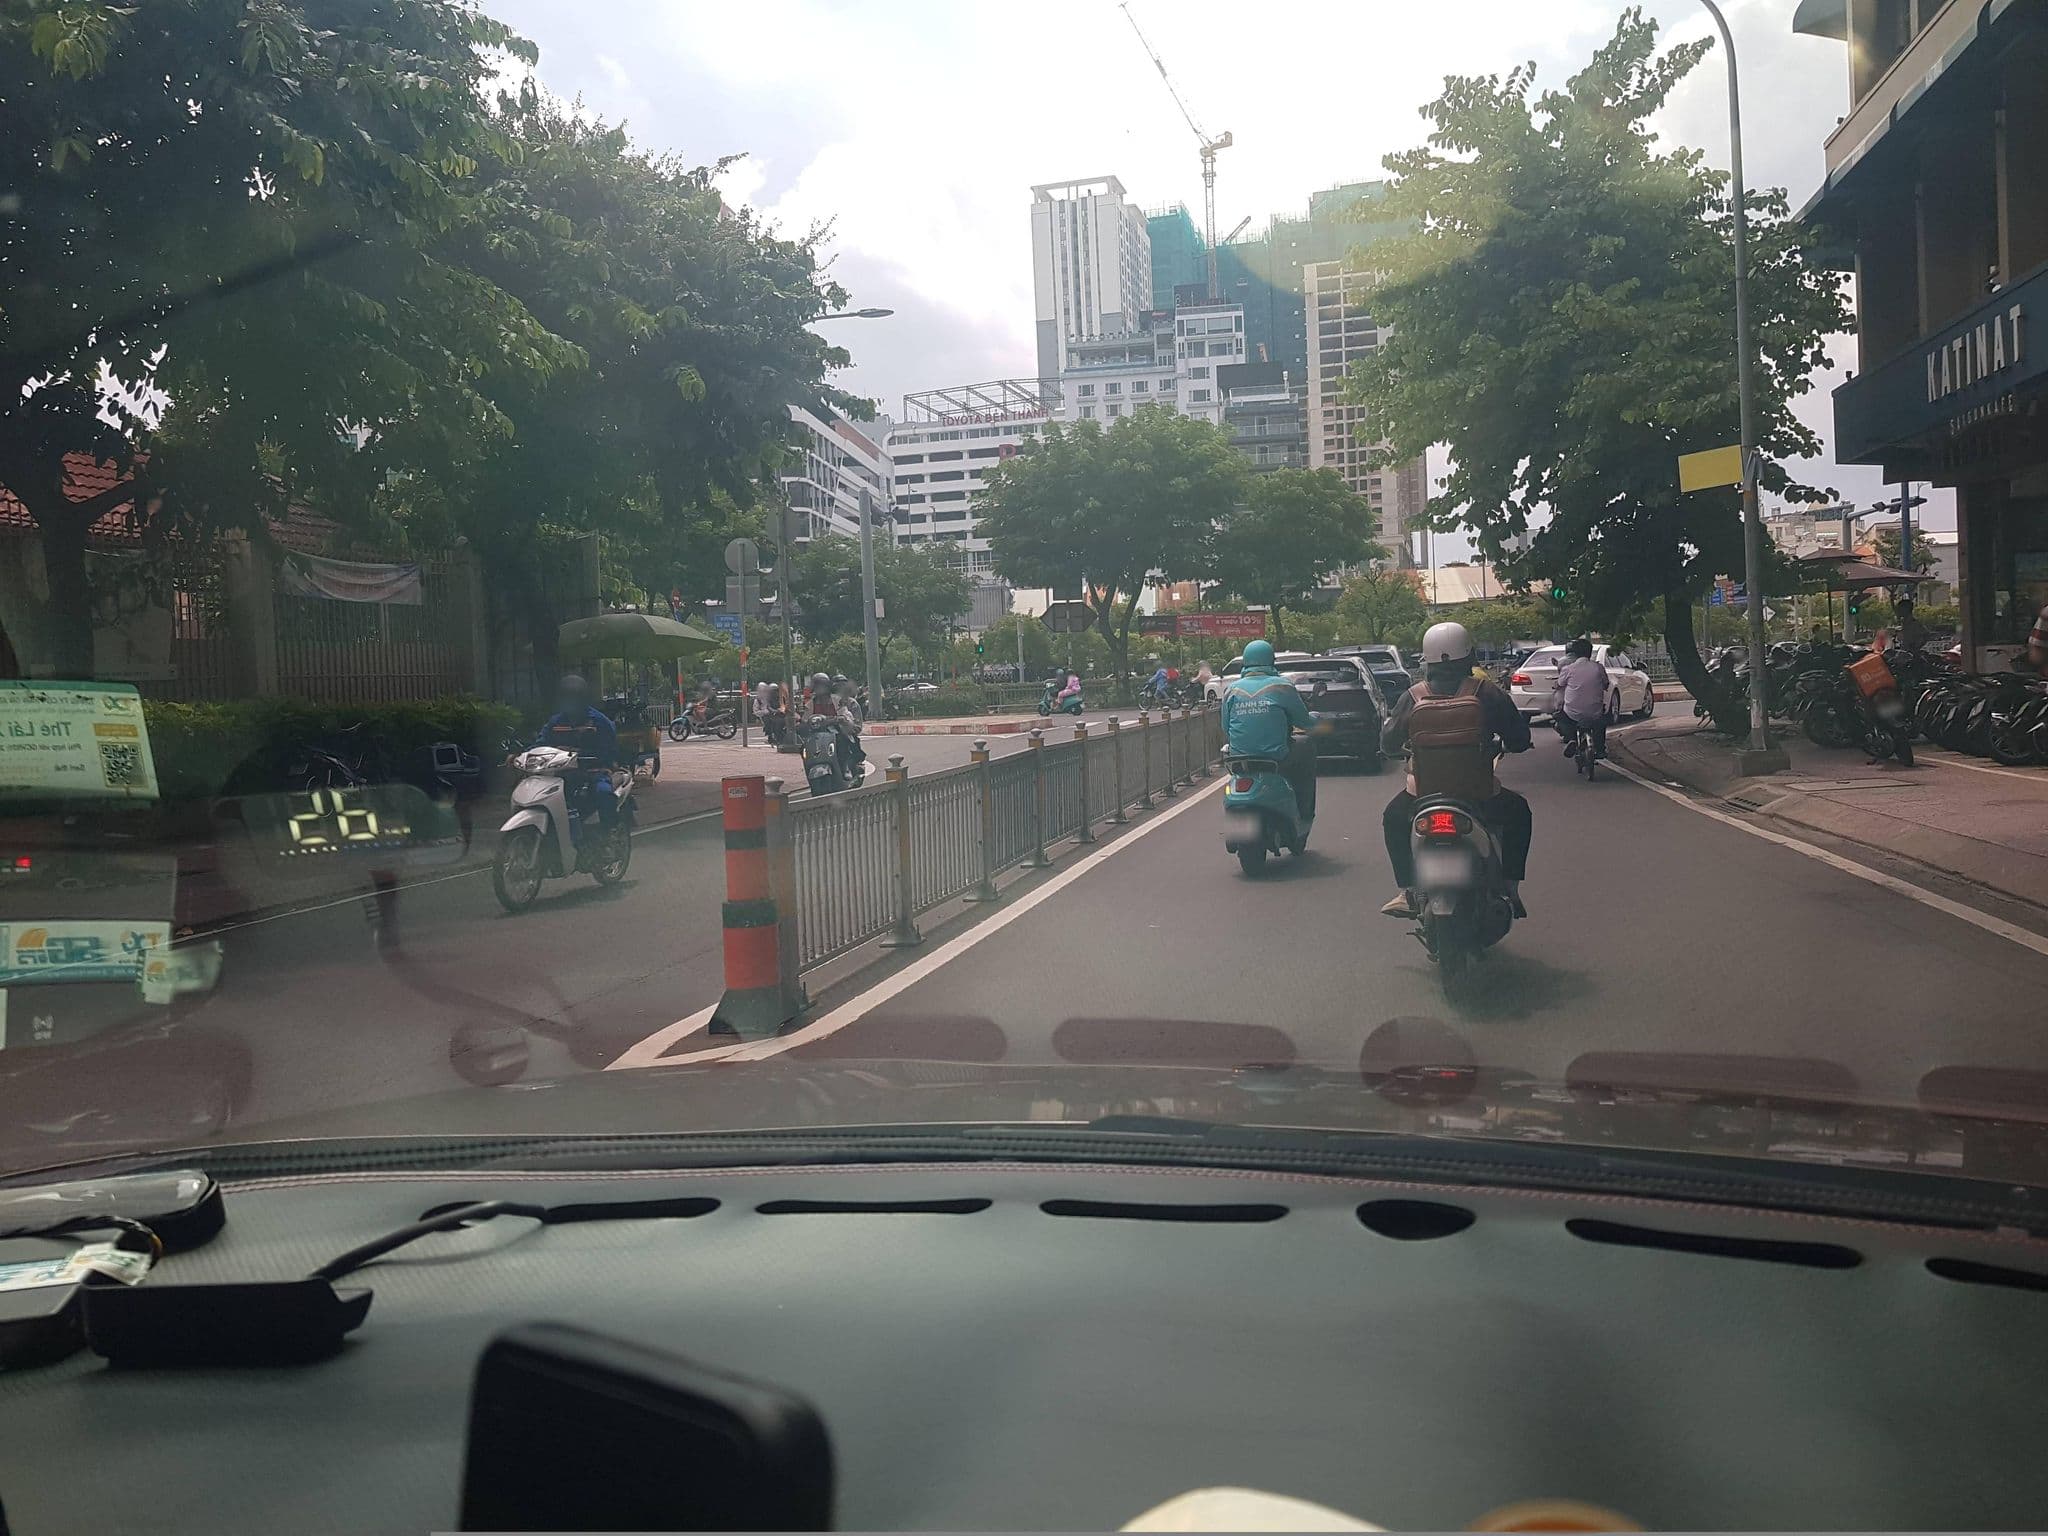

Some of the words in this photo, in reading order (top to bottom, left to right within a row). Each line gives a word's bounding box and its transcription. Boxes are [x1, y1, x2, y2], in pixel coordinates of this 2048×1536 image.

[1926, 303, 2022, 404] KATINAT
[942, 414, 983, 427] TOYOTA
[1238, 615, 1262, 625] 10%
